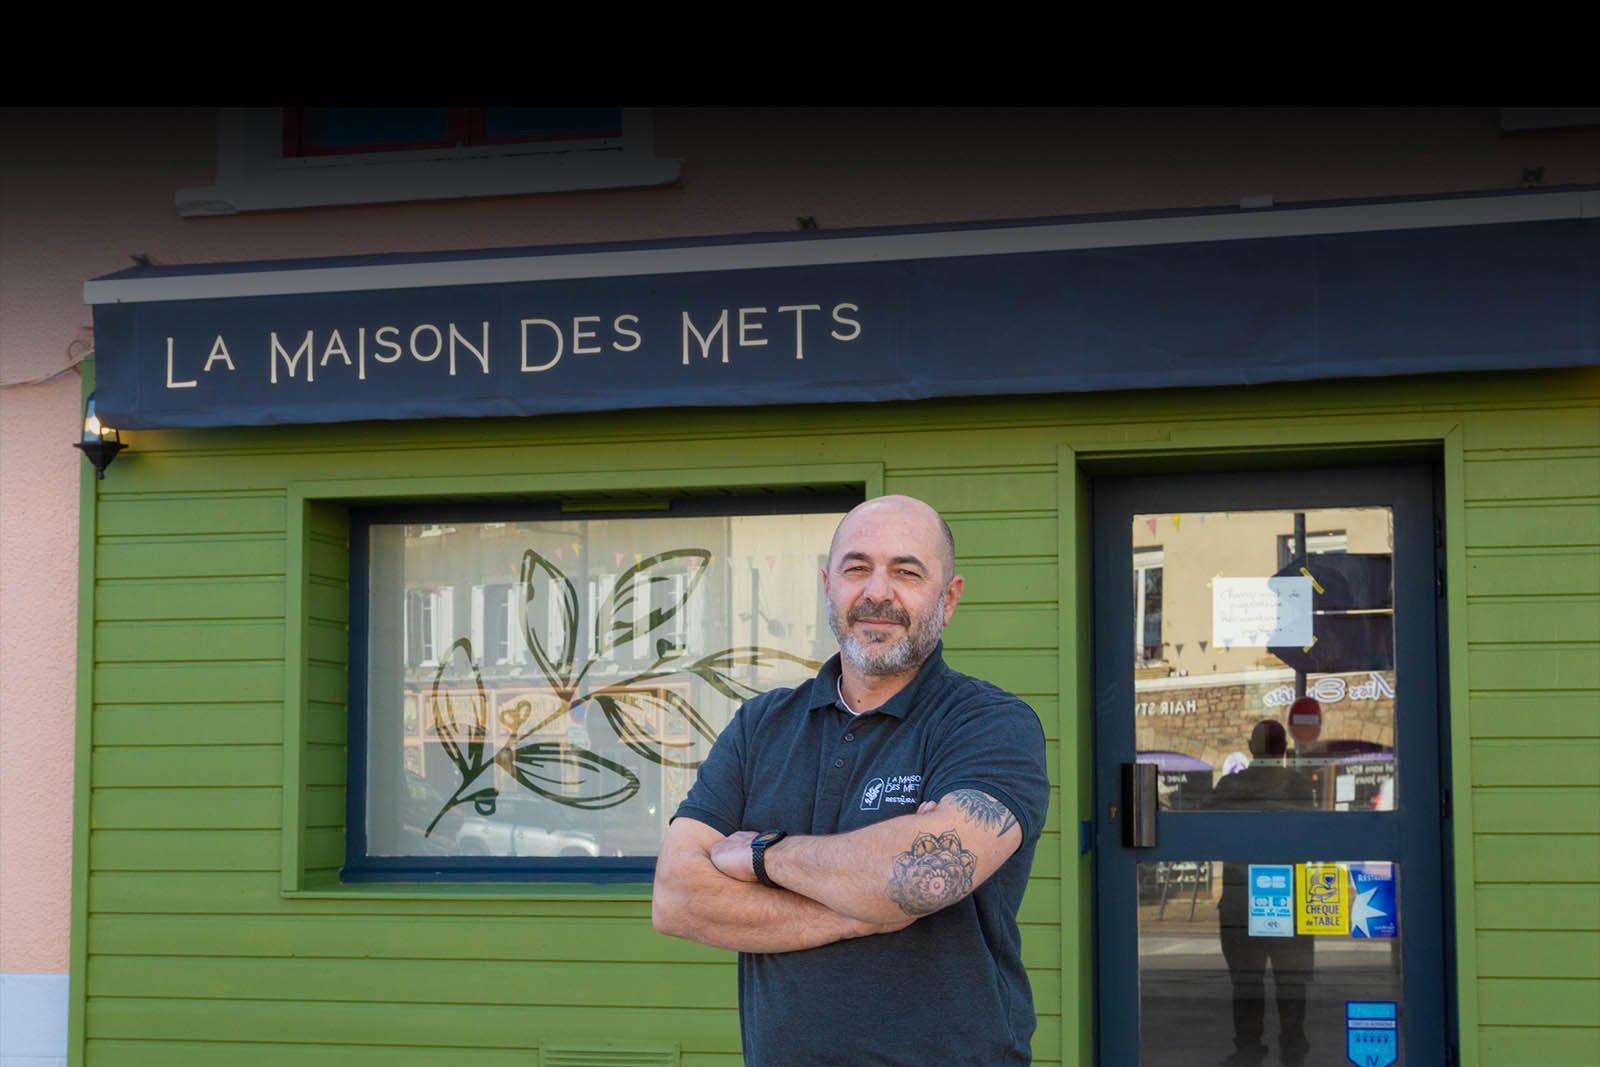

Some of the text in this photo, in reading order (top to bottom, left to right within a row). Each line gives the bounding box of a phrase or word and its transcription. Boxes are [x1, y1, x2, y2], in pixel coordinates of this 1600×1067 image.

[166, 303, 863, 389] LA MAISON DES METS
[887, 776, 897, 784] LA
[885, 784, 900, 793] DES
[1306, 904, 1340, 915] CHEQUE
[1314, 917, 1340, 926] TABLE
